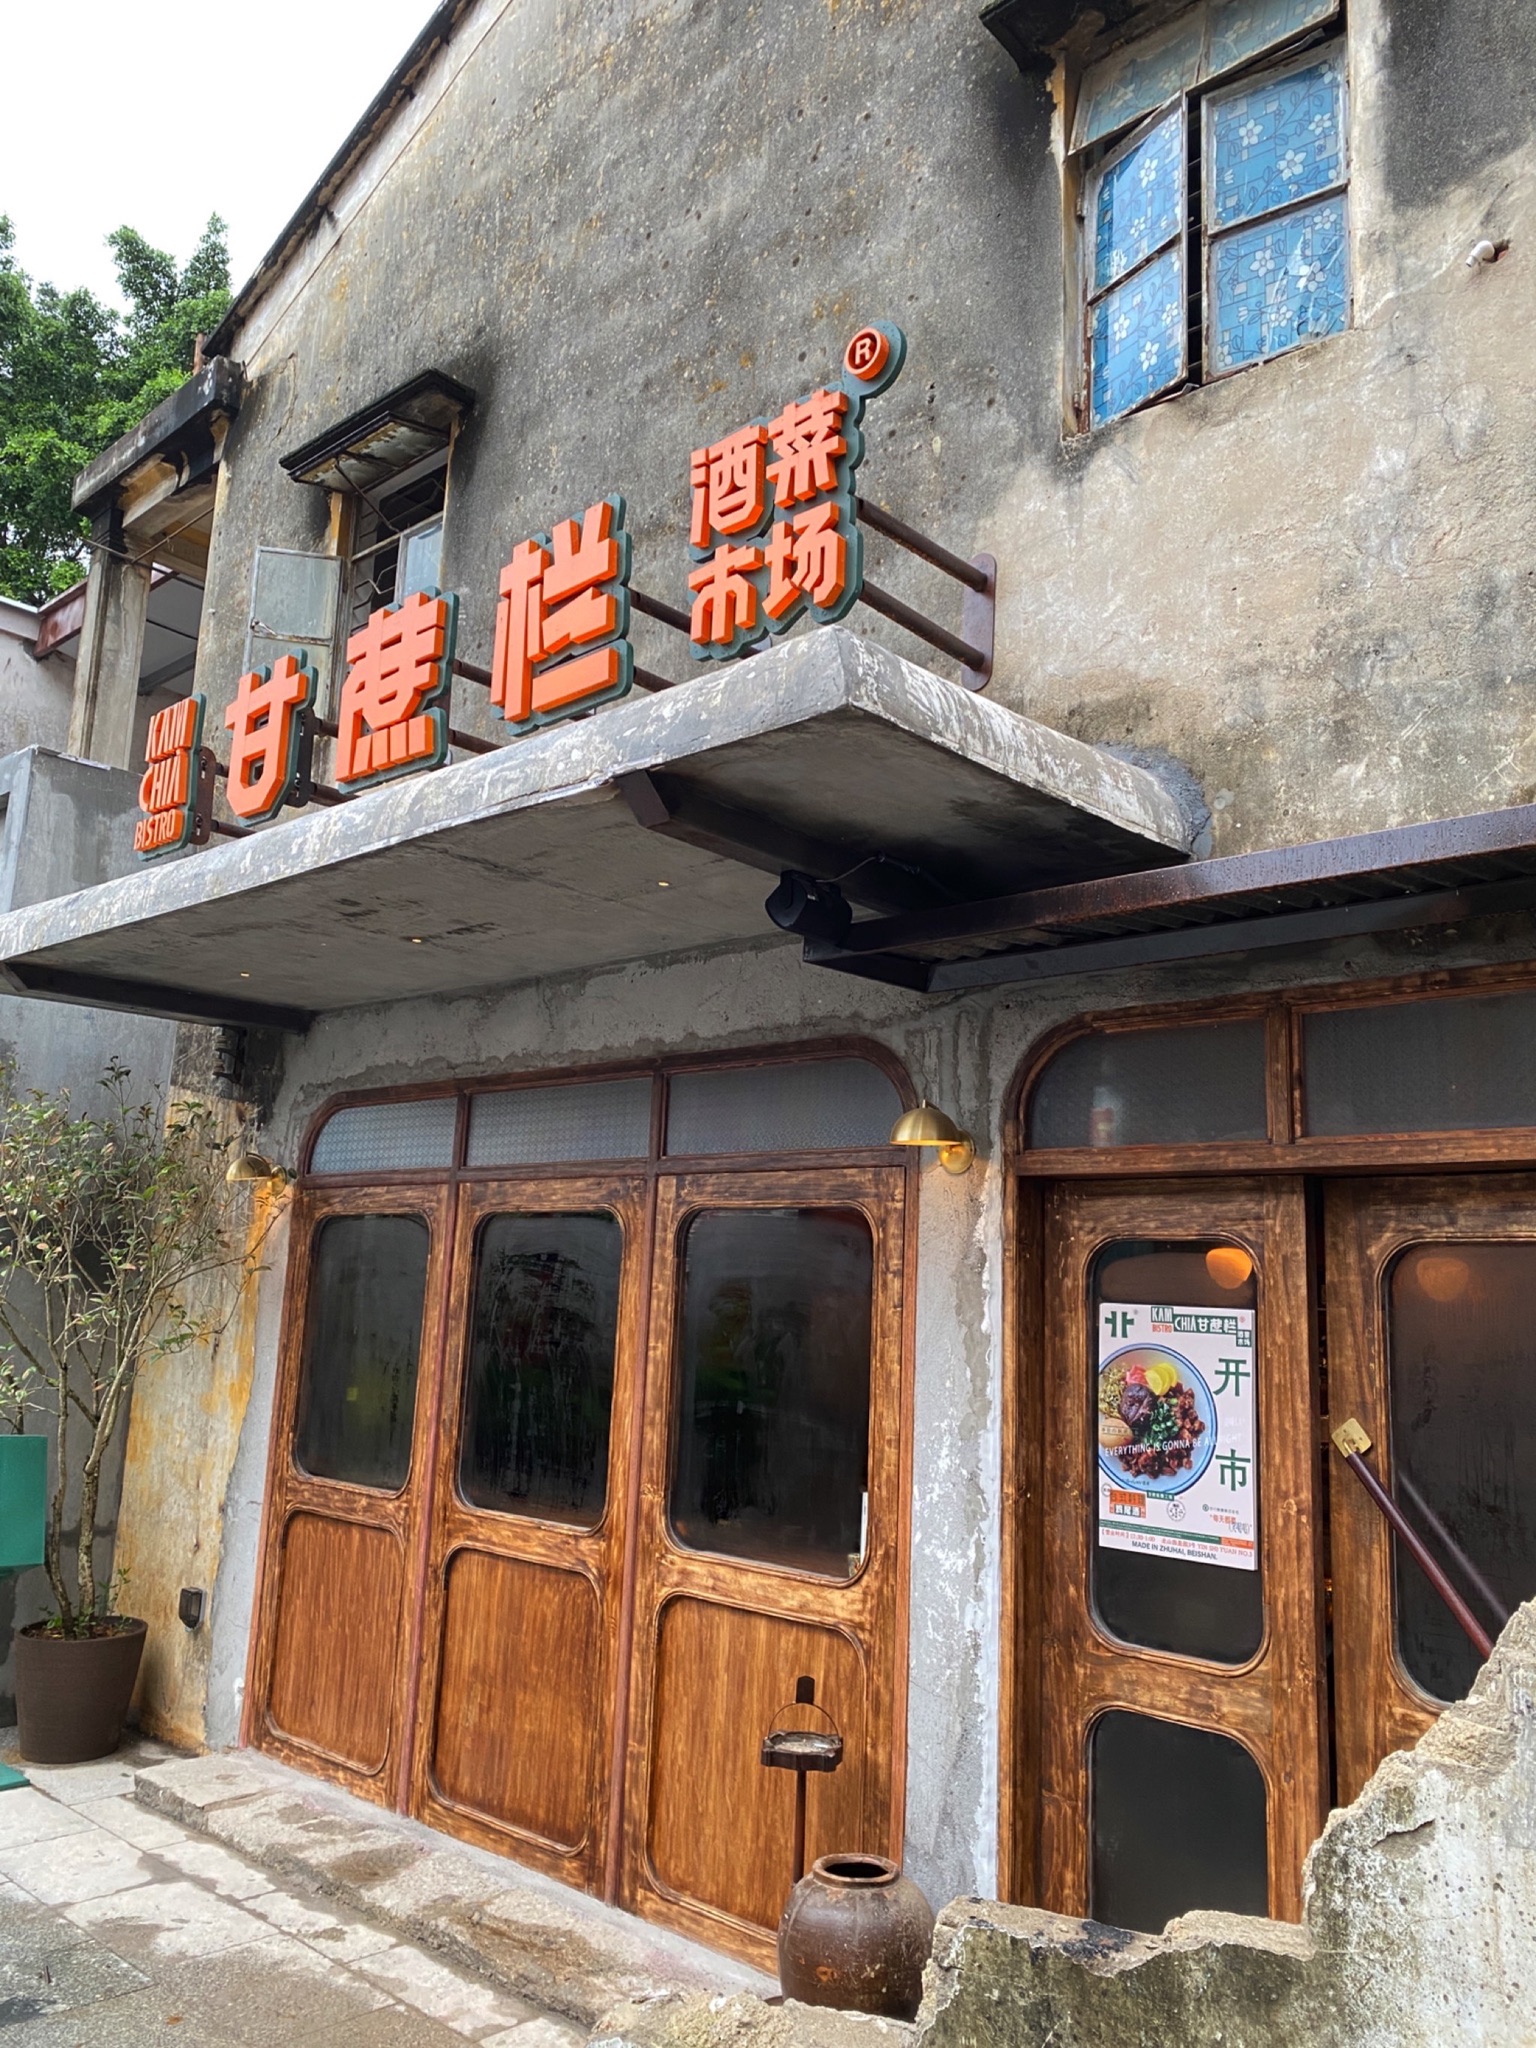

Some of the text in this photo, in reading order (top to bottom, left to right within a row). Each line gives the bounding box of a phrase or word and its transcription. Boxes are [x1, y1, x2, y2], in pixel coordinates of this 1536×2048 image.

[690, 389, 848, 549] 酒菜
[690, 502, 846, 645] 市场
[225, 500, 620, 818] 甘蔗栏
[139, 751, 189, 814] CHIA
[133, 808, 184, 852] BISTRO
[1152, 1323, 1173, 1333] BISTRO
[1105, 1444, 1151, 1457] EVERYTHING
[1154, 1443, 1161, 1452] IS
[1162, 1440, 1190, 1451] GONNA
[1193, 1438, 1201, 1447] BE
[1132, 1540, 1217, 1560] MADE IN ZHUHAI, BEISHAN.
